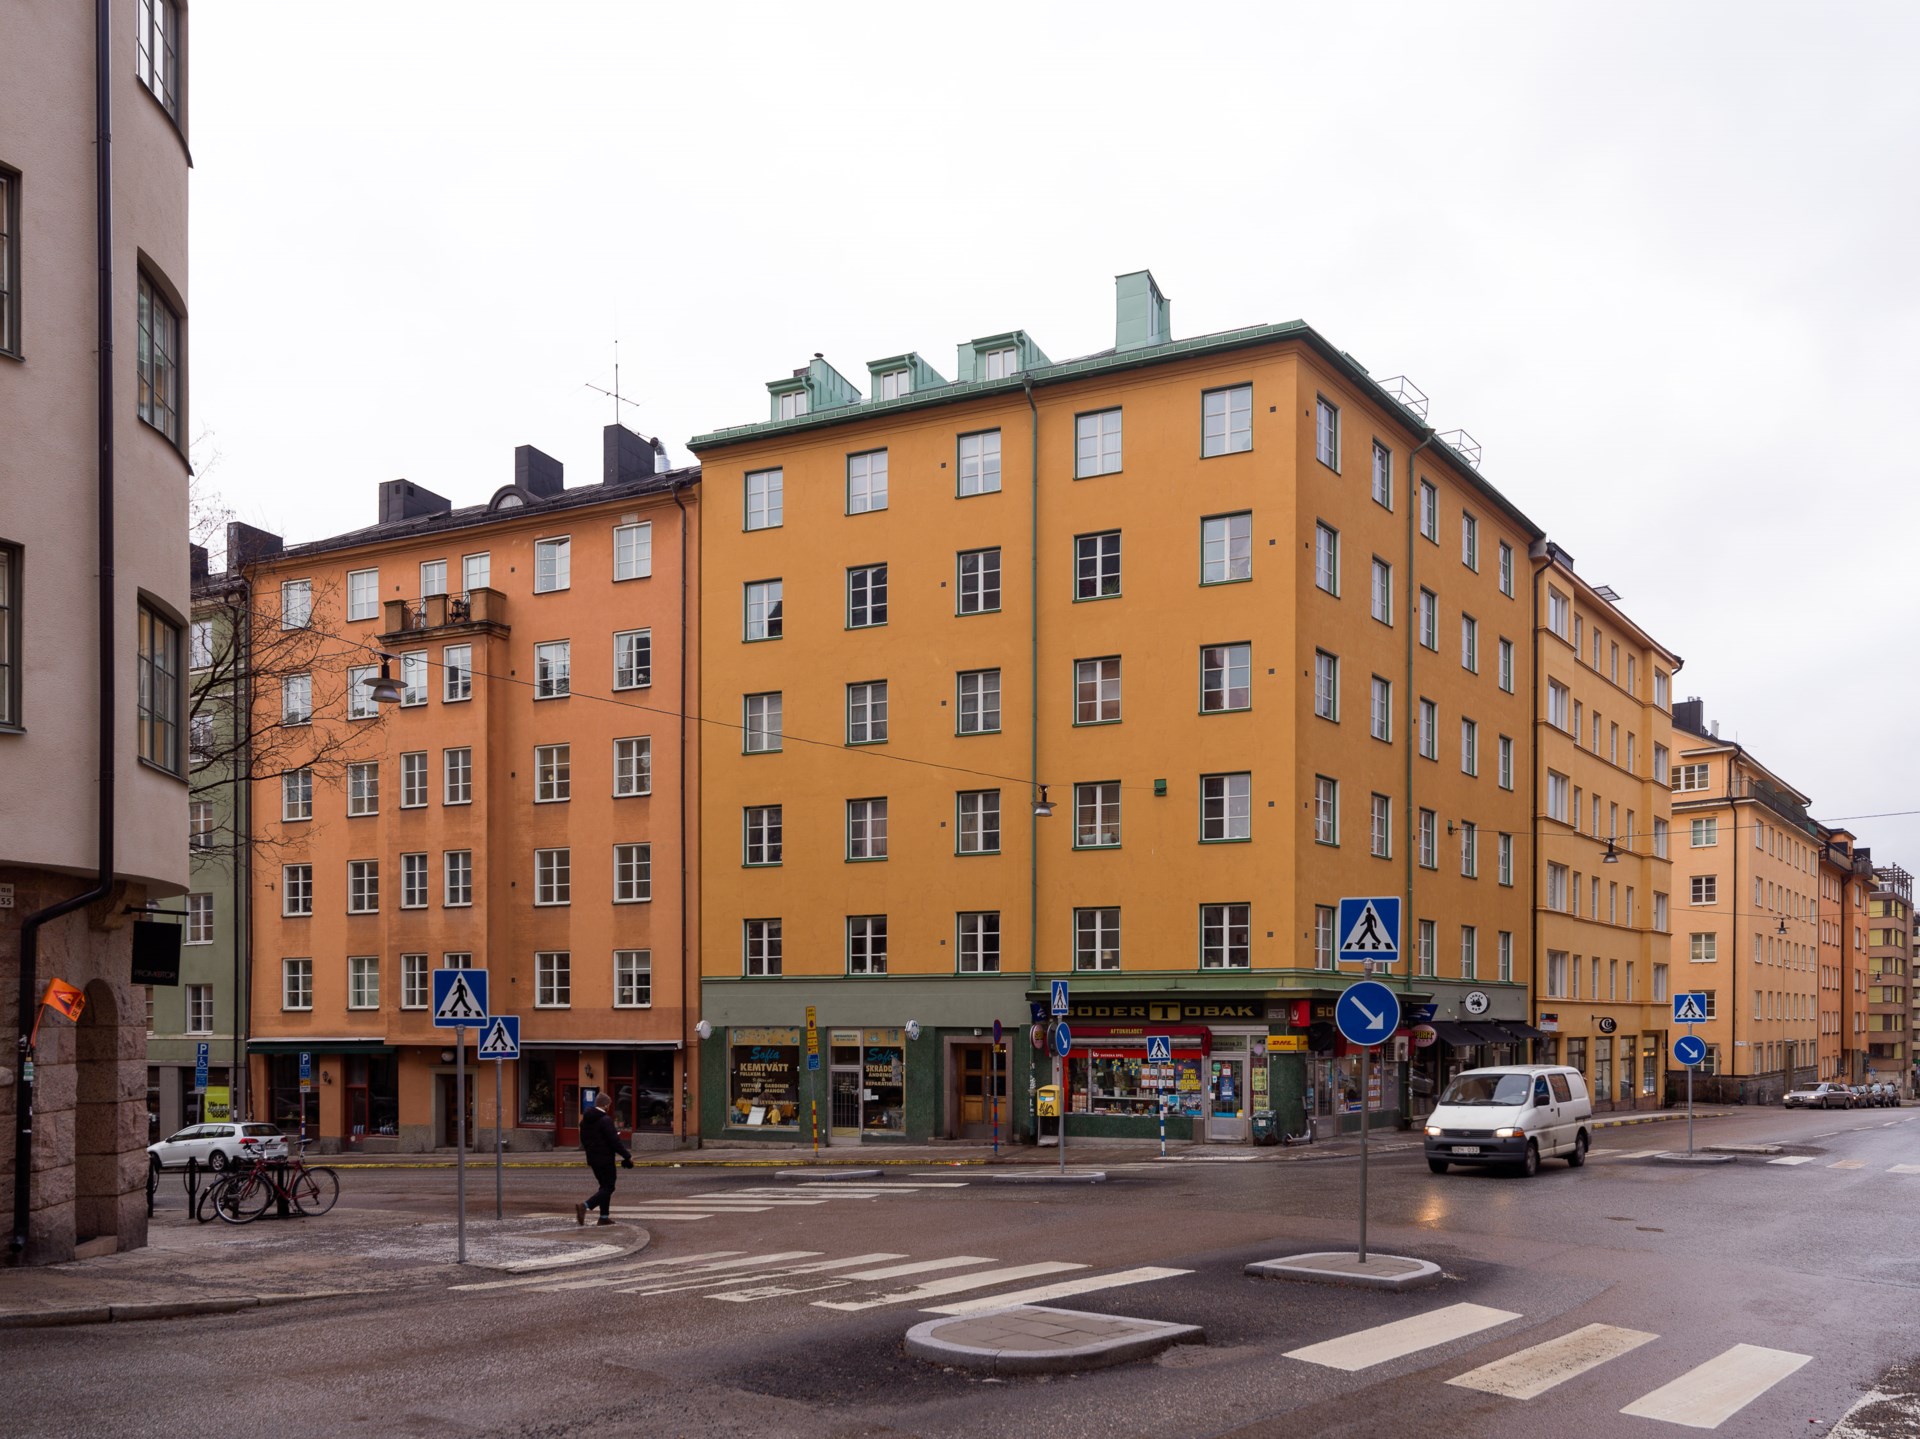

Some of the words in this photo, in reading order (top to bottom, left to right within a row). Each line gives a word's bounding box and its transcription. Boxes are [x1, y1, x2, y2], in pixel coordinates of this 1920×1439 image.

[200, 1044, 207, 1054] P
[302, 1054, 309, 1064] P
[751, 1046, 781, 1063] Sofia
[740, 1062, 789, 1072] KEMTVÄTT
